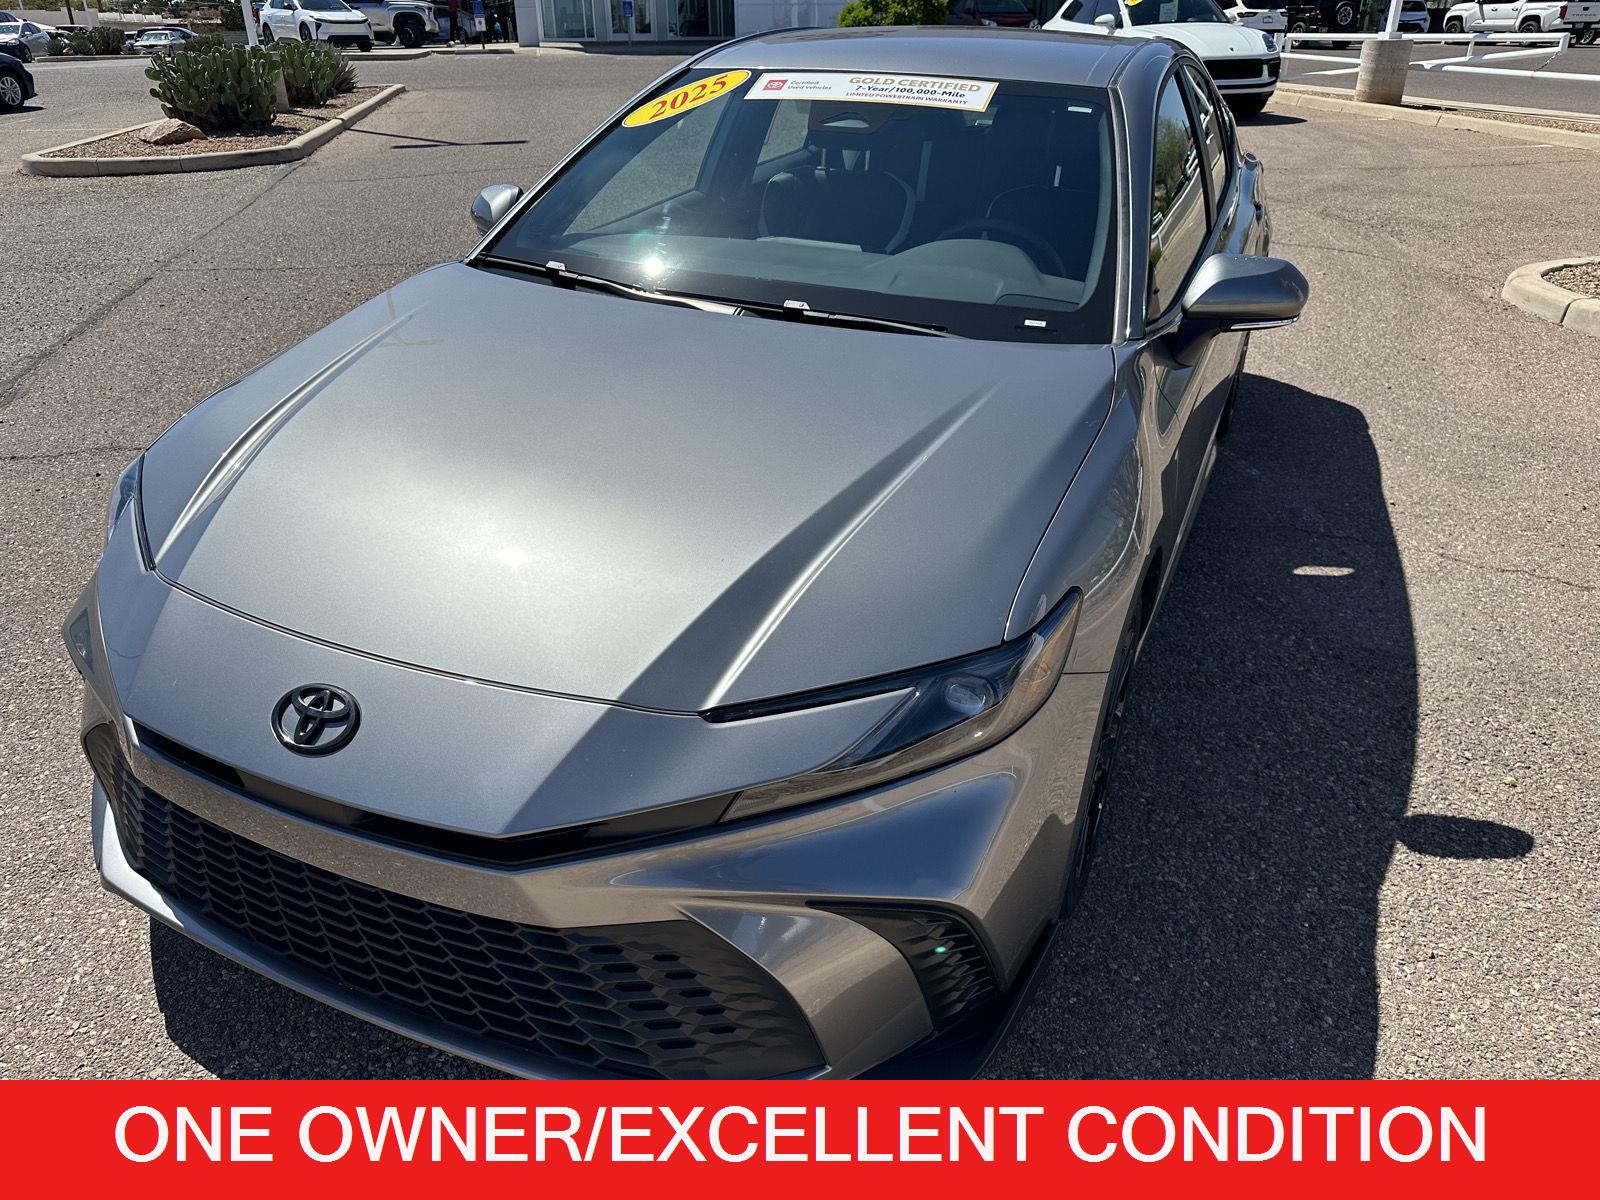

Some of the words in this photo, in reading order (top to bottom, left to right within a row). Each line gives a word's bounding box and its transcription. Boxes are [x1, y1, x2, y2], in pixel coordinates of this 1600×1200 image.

[849, 77, 895, 85] GOLD
[898, 79, 981, 92] CERTIFIED
[855, 85, 966, 98] 7-Year/100,000-Mile
[648, 74, 728, 120] 2025
[876, 93, 923, 101] POWERTRAIN
[925, 96, 968, 105] WARRANTY
